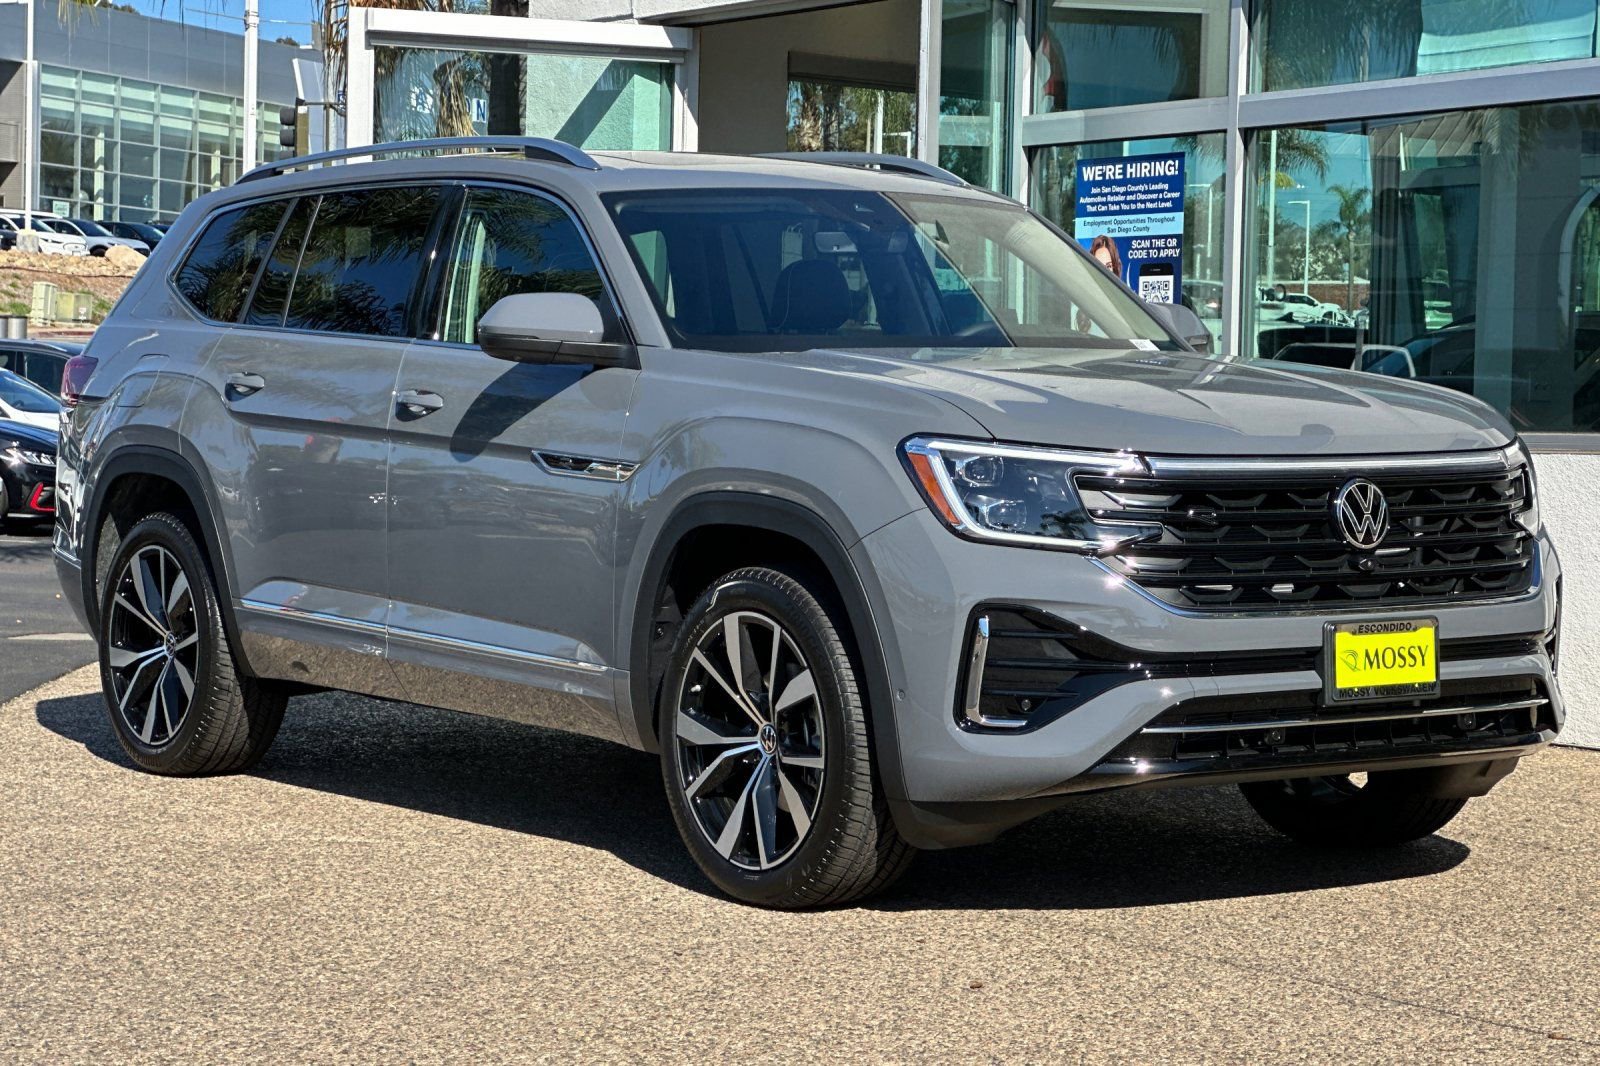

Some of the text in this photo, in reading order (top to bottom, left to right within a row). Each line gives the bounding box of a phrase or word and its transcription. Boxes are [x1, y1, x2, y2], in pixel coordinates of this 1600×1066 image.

[1082, 159, 1179, 181] WE'RE HIRING!
[1091, 182, 1169, 194] Join San Diego County's Leading
[1080, 195, 1107, 204] Automotive
[1107, 194, 1126, 202] Retailer
[1126, 193, 1136, 201] and
[1137, 192, 1159, 200] Discover
[1163, 191, 1181, 199] Career
[1086, 204, 1097, 212] That
[1108, 203, 1120, 211] Take
[1120, 202, 1130, 210] You
[1137, 201, 1145, 209] the
[1146, 201, 1158, 209] Next
[1113, 218, 1146, 226] Opportunities
[1147, 216, 1176, 224] Throughout
[1107, 225, 1150, 234] San Diego County
[1131, 238, 1177, 249] SCAN THE QR
[1128, 248, 1180, 259] CODE TO APPLY
[1358, 622, 1412, 634] ESCONDIDO
[1363, 645, 1428, 671] MOSSY
